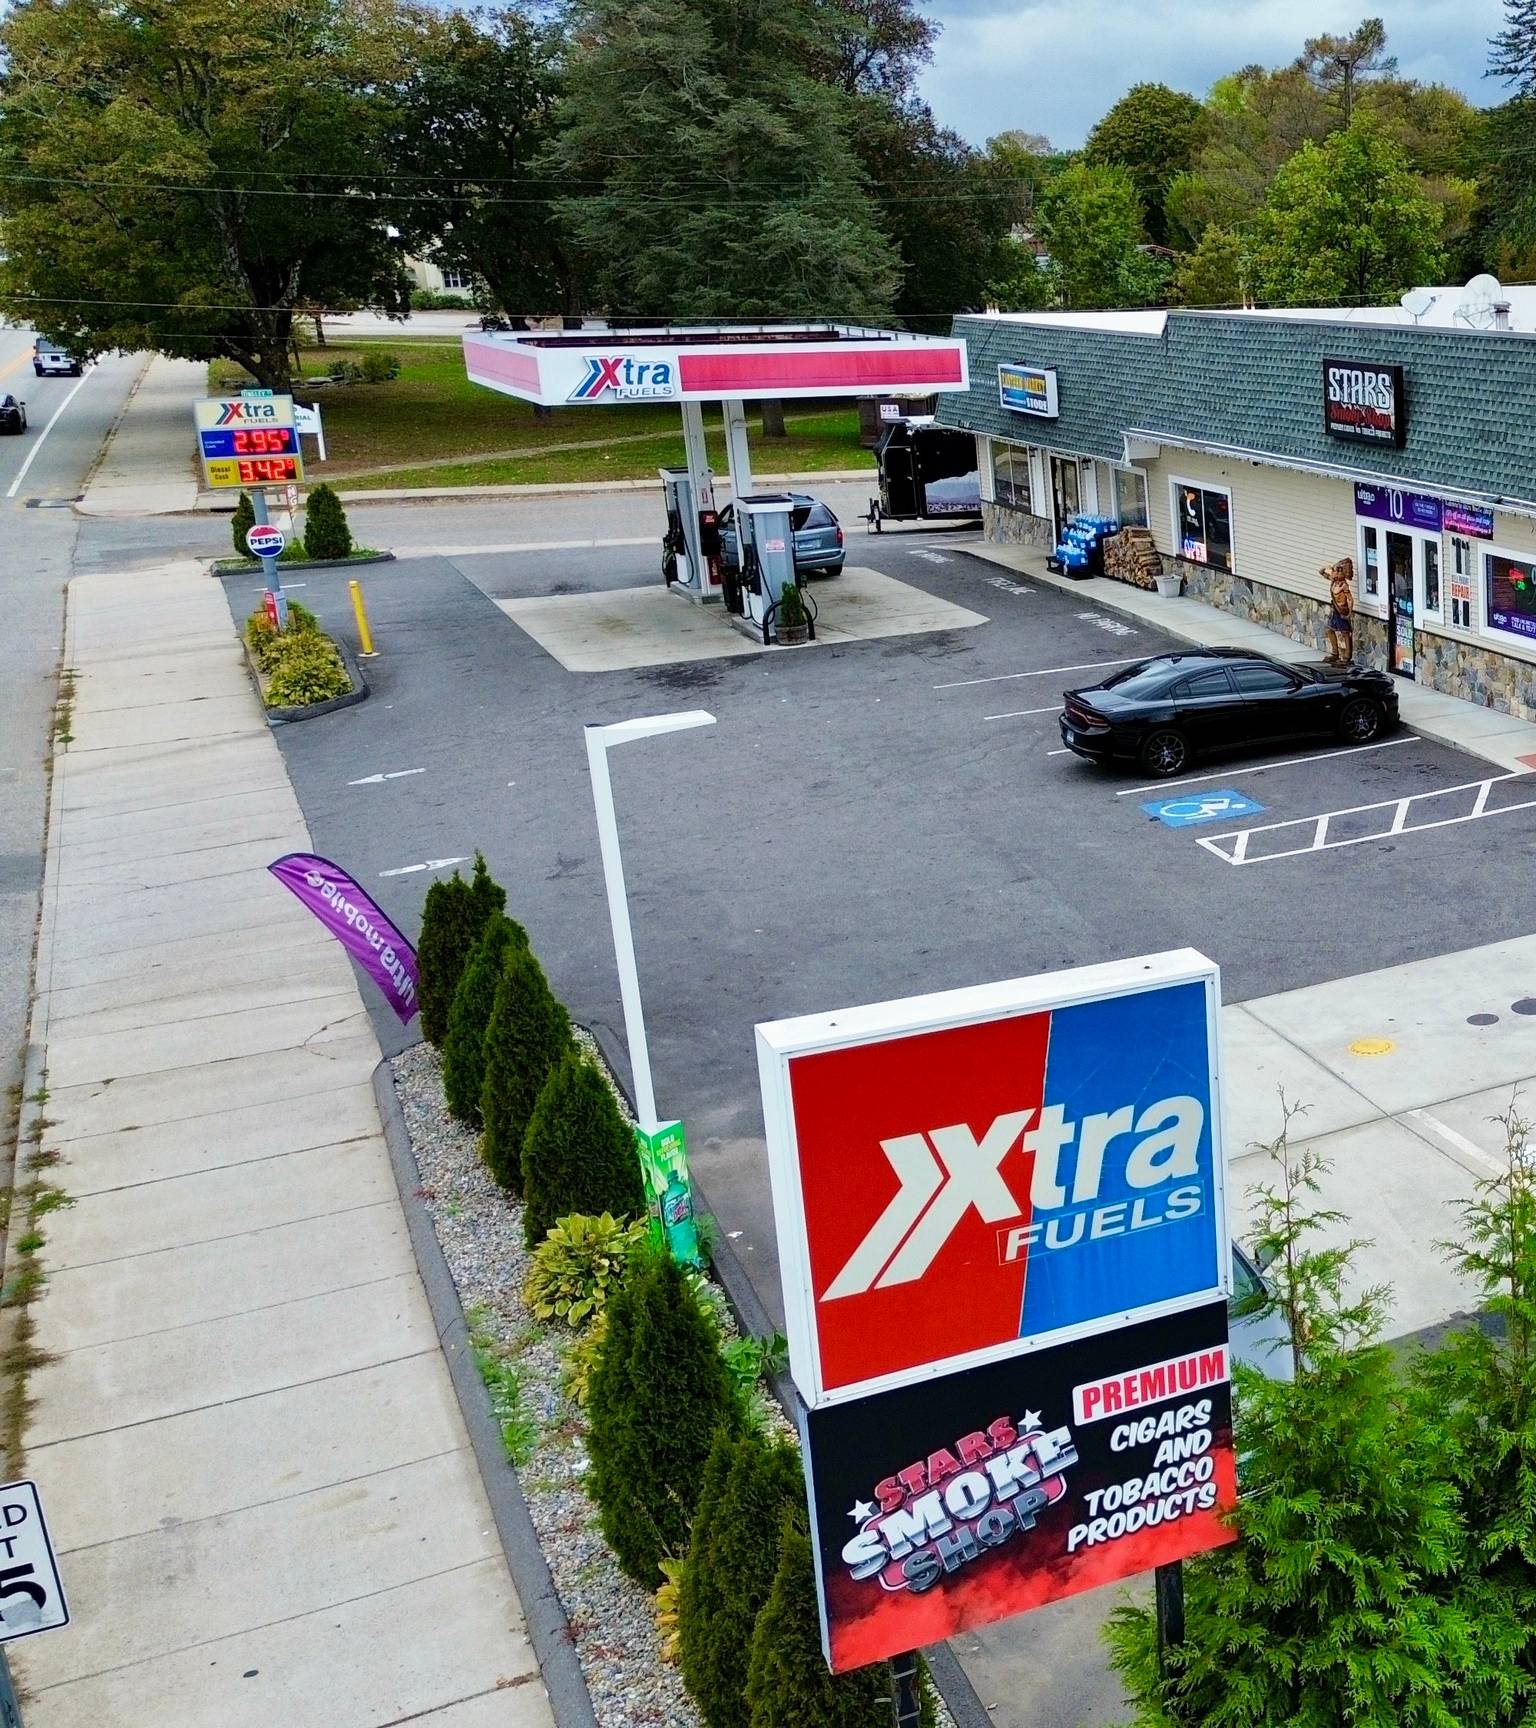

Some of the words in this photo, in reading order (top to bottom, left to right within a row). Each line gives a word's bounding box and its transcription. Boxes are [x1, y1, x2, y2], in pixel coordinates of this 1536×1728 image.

[575, 358, 670, 398] Xtra
[619, 386, 673, 396] FUELS
[1328, 367, 1390, 409] STARS
[215, 402, 275, 425] Xtra
[250, 537, 283, 546] PEPSI
[320, 881, 385, 950] mobile
[380, 946, 415, 1007] ultra
[819, 1095, 1204, 1303] Xtra
[1004, 1184, 1201, 1261] FUELS
[1082, 1349, 1225, 1419] PREMIUM
[1110, 1399, 1212, 1452] CIGARS
[1153, 1428, 1212, 1469] AND
[873, 1415, 1017, 1513] STARS
[1083, 1455, 1215, 1517] TOBACCO
[841, 1425, 1080, 1581] SMOKE
[1066, 1481, 1218, 1553] PRODUCTS
[902, 1487, 1050, 1594] SHOP
